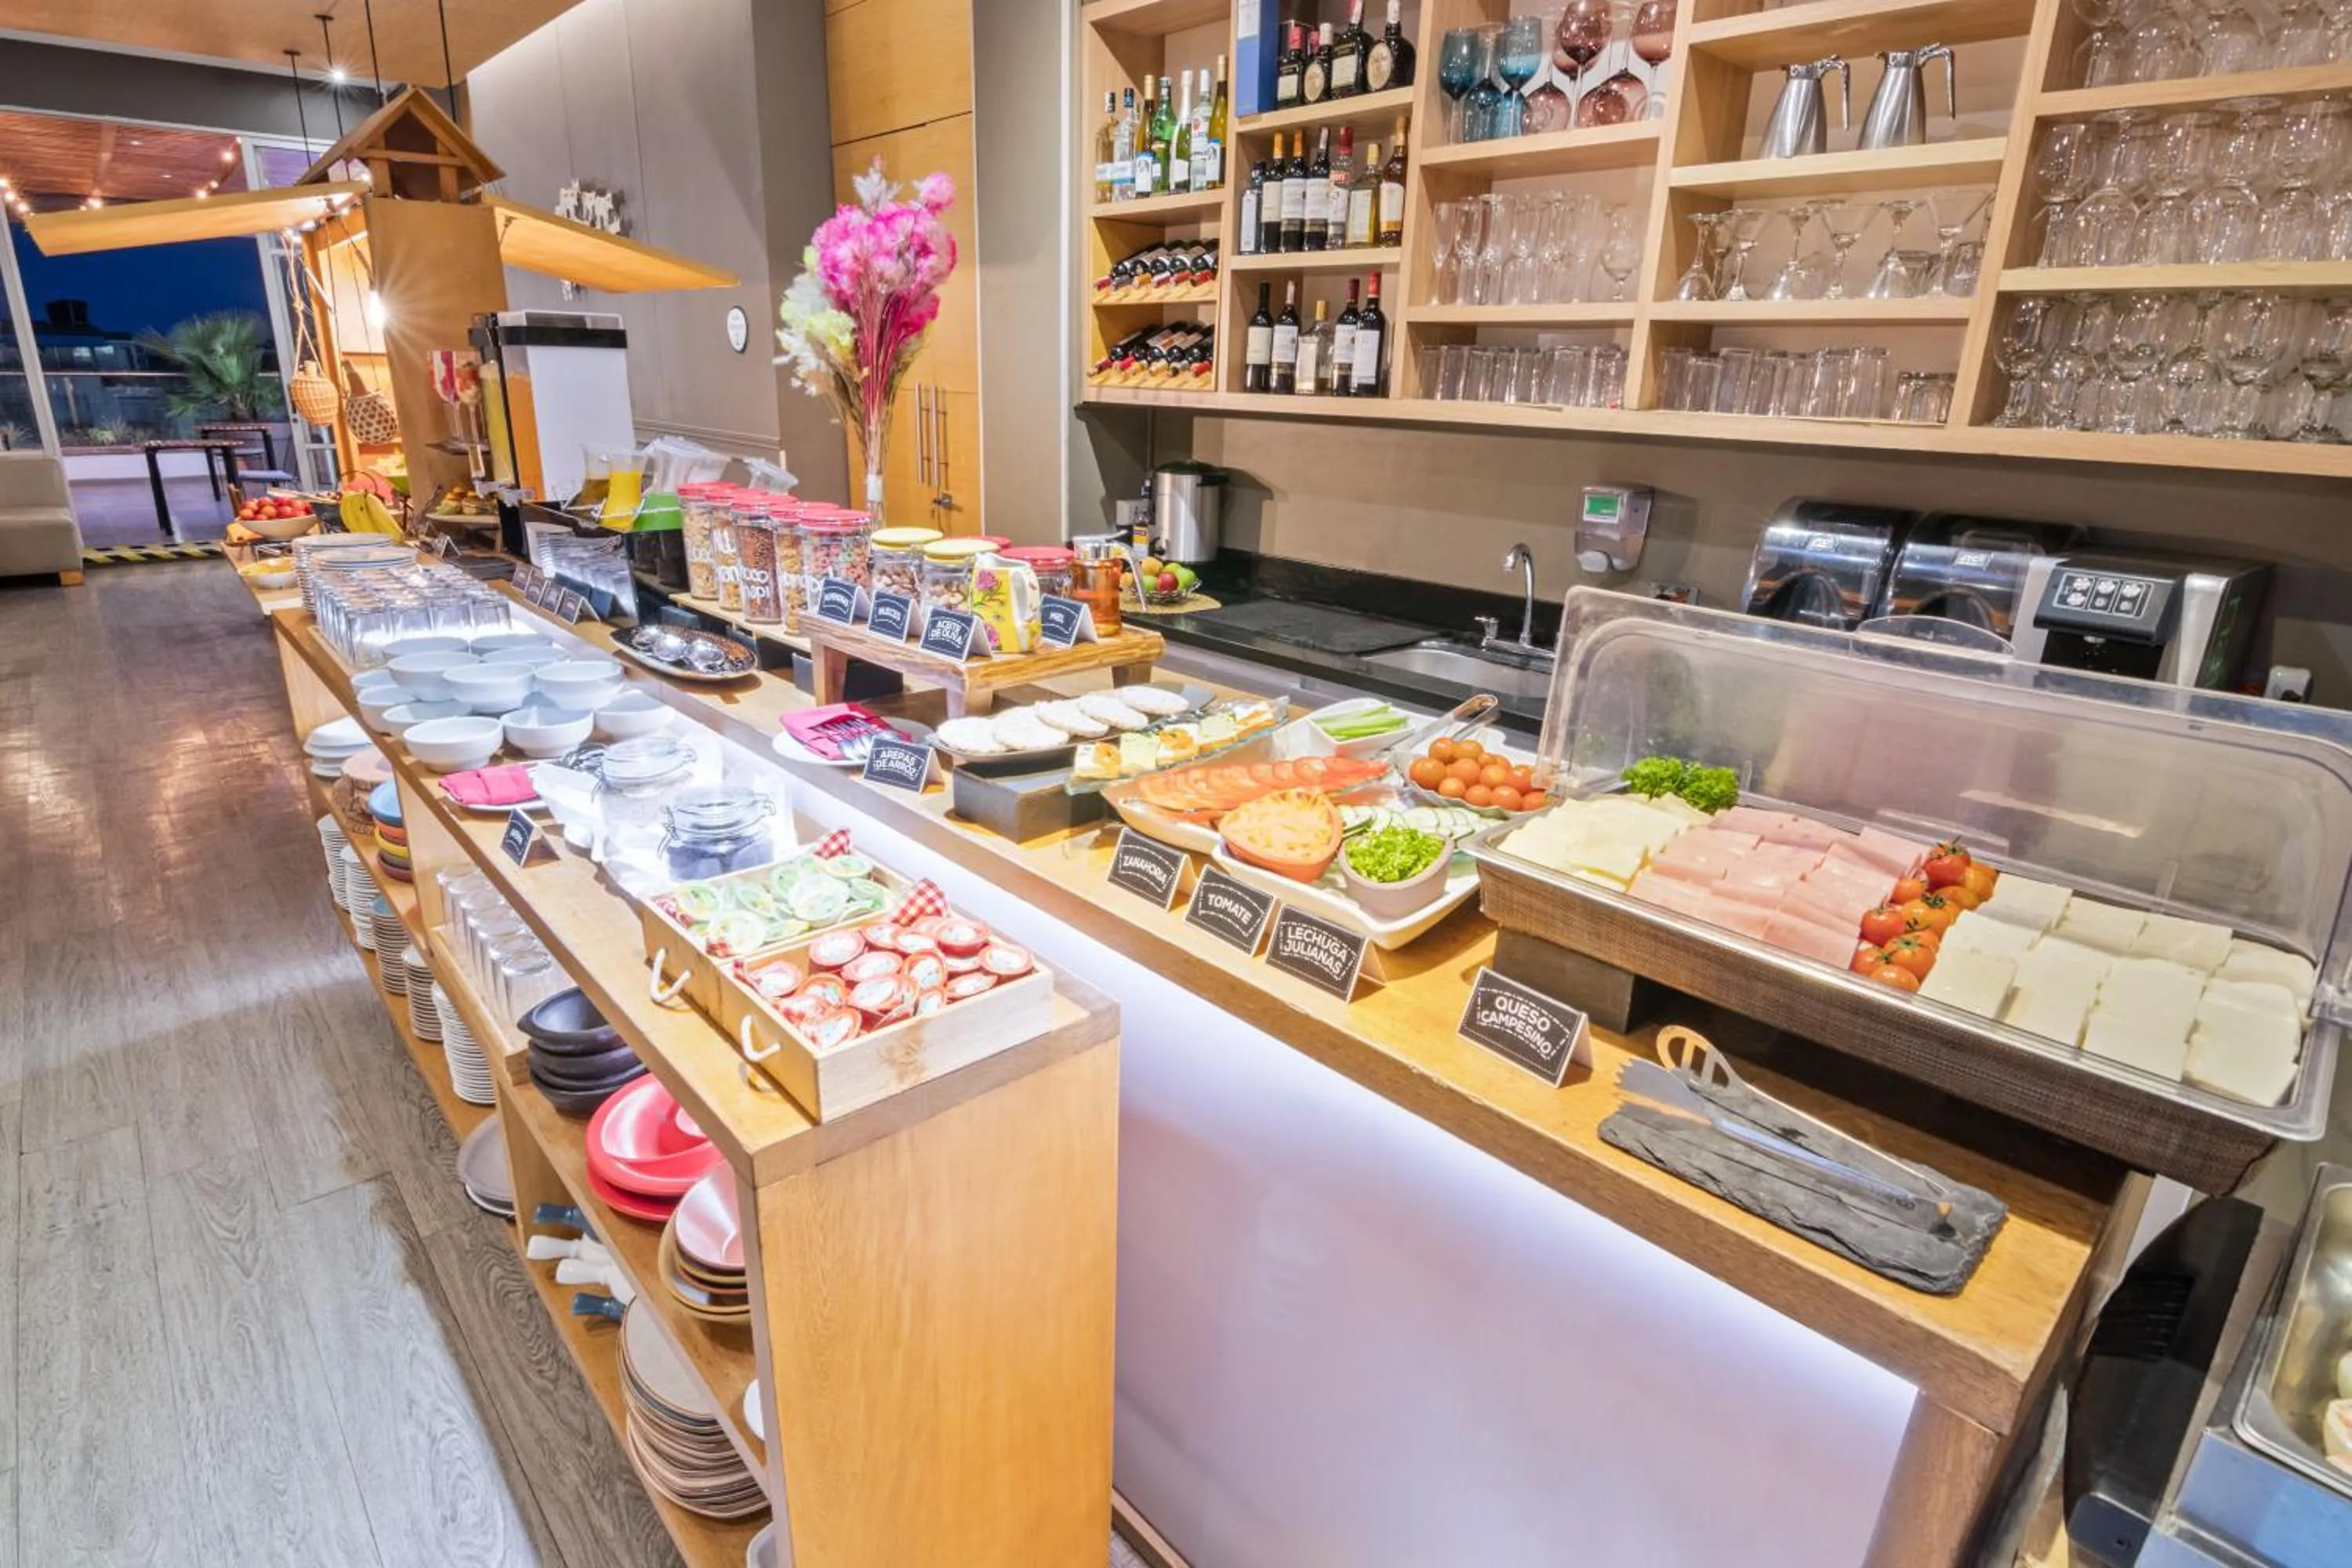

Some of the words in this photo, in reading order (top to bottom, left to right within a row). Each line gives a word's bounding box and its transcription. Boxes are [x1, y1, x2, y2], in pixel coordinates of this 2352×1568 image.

[931, 628, 942, 637] DE
[942, 629, 964, 645] OLIVA
[936, 620, 962, 633] ACEITE
[876, 758, 888, 768] DE
[888, 760, 916, 777] ARROZ
[880, 750, 916, 767] AREPAS
[1123, 855, 1167, 885] ZANAHORIA
[1207, 893, 1252, 924] TOMATE
[1283, 939, 1343, 975] JULIANAS
[1287, 926, 1348, 963] LECHUGA
[1495, 996, 1551, 1032] QUESO
[1481, 1010, 1552, 1054] CAMPESINO
